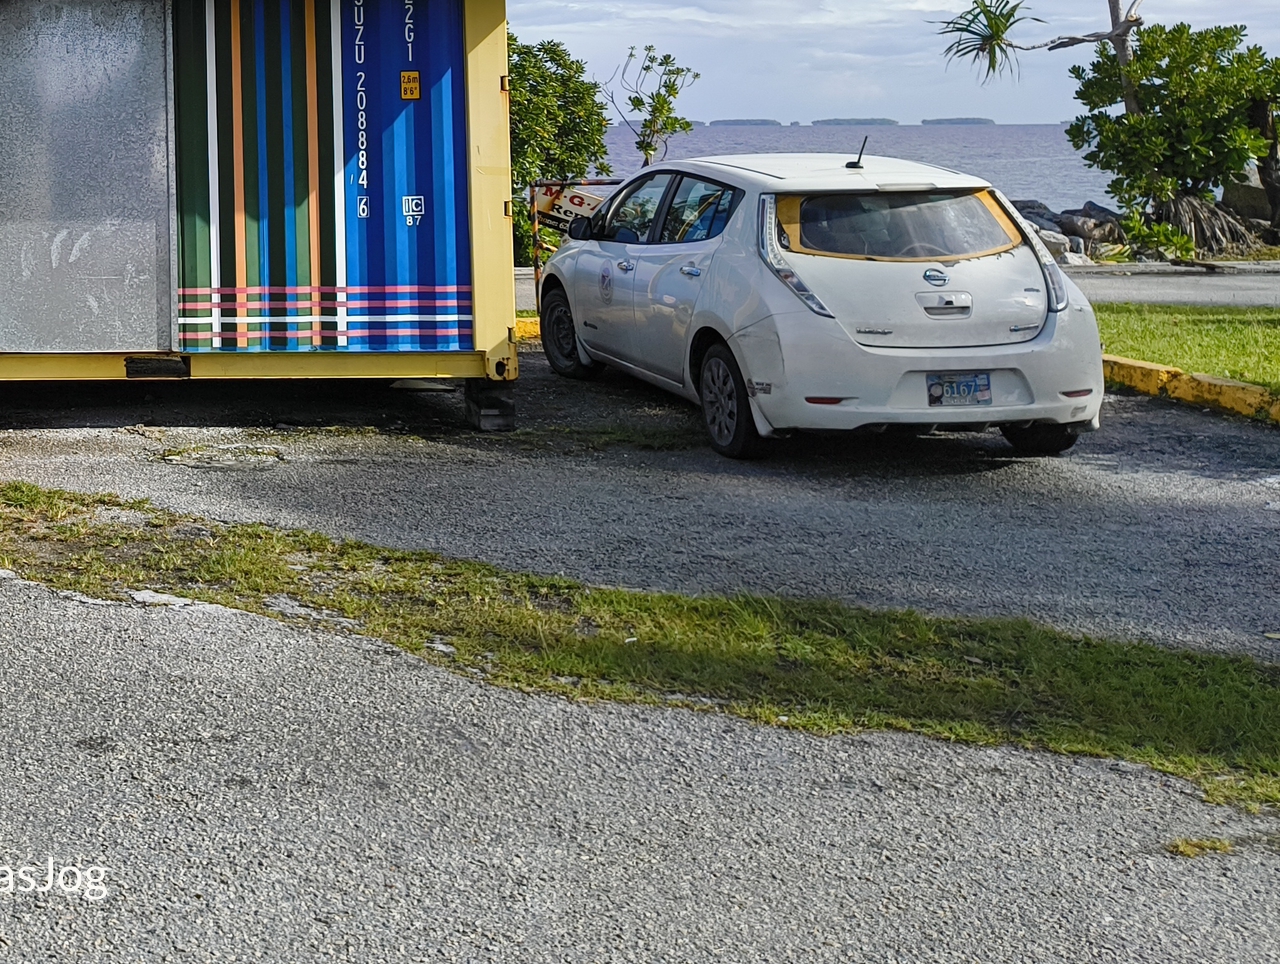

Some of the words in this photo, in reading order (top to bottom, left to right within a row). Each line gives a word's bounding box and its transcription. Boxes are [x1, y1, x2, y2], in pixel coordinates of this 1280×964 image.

[356, 71, 368, 189] 208884
[358, 197, 369, 218] 6
[406, 215, 422, 226] 87
[943, 382, 975, 397] 6167
